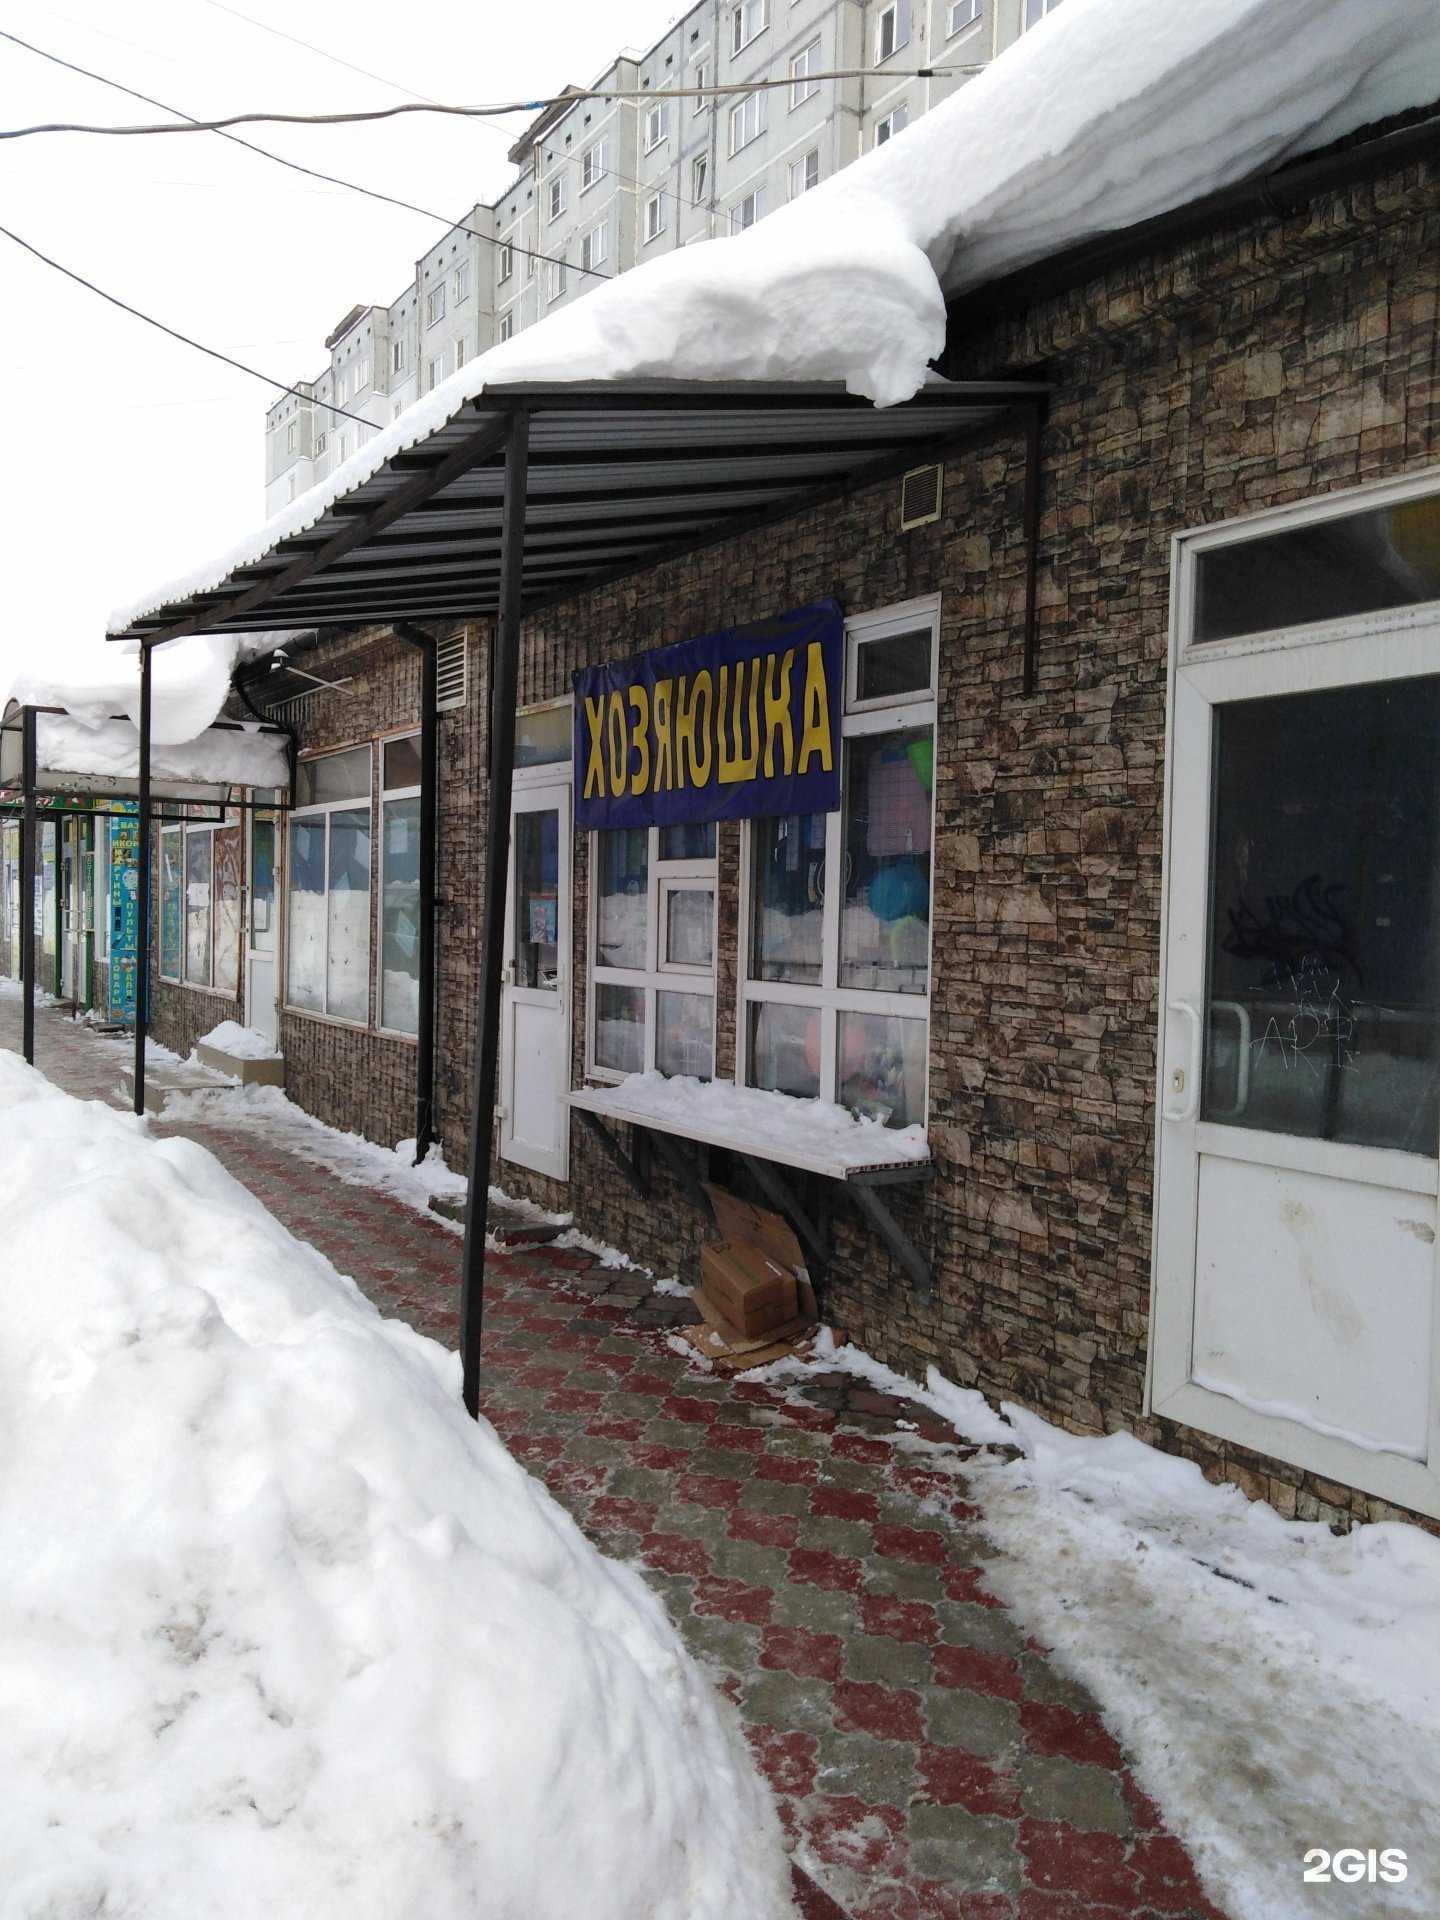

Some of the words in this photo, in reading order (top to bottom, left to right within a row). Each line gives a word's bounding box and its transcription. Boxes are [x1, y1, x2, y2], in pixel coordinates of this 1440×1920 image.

[583, 642, 833, 799] ХОЗЯЮШКА
[125, 902, 135, 949] ПУЛЬТЫ
[112, 957, 121, 1005] ТОВАРЫ
